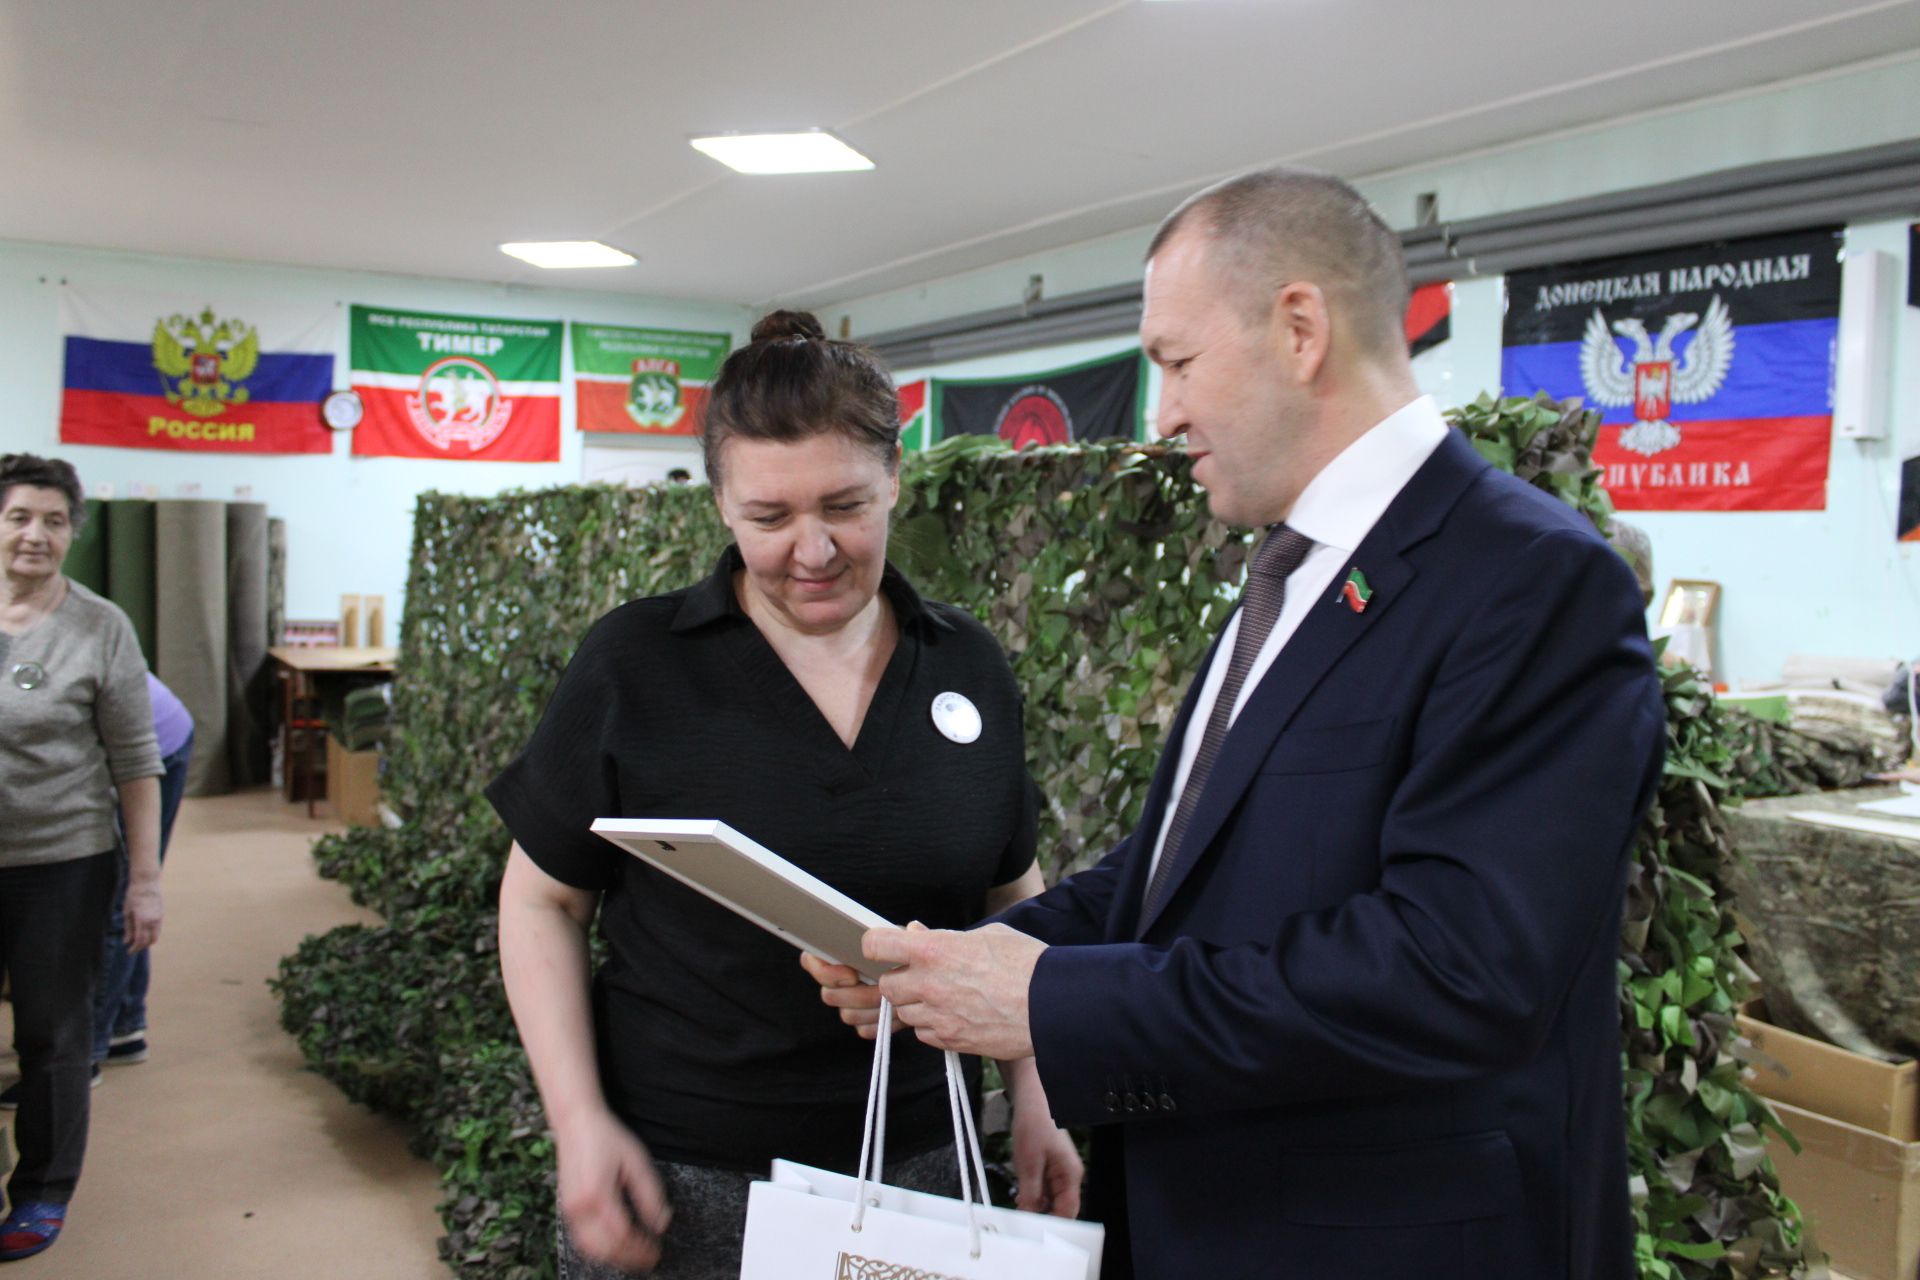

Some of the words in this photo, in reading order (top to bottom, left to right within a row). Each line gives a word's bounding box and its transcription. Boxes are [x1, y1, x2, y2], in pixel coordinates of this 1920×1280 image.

[1535, 271, 1661, 312] ДОНЕЦКАЯ
[1668, 254, 1811, 290] НАРОДНАЯ
[416, 331, 504, 356] ТИМЕР
[148, 416, 256, 443] РОССИЯ
